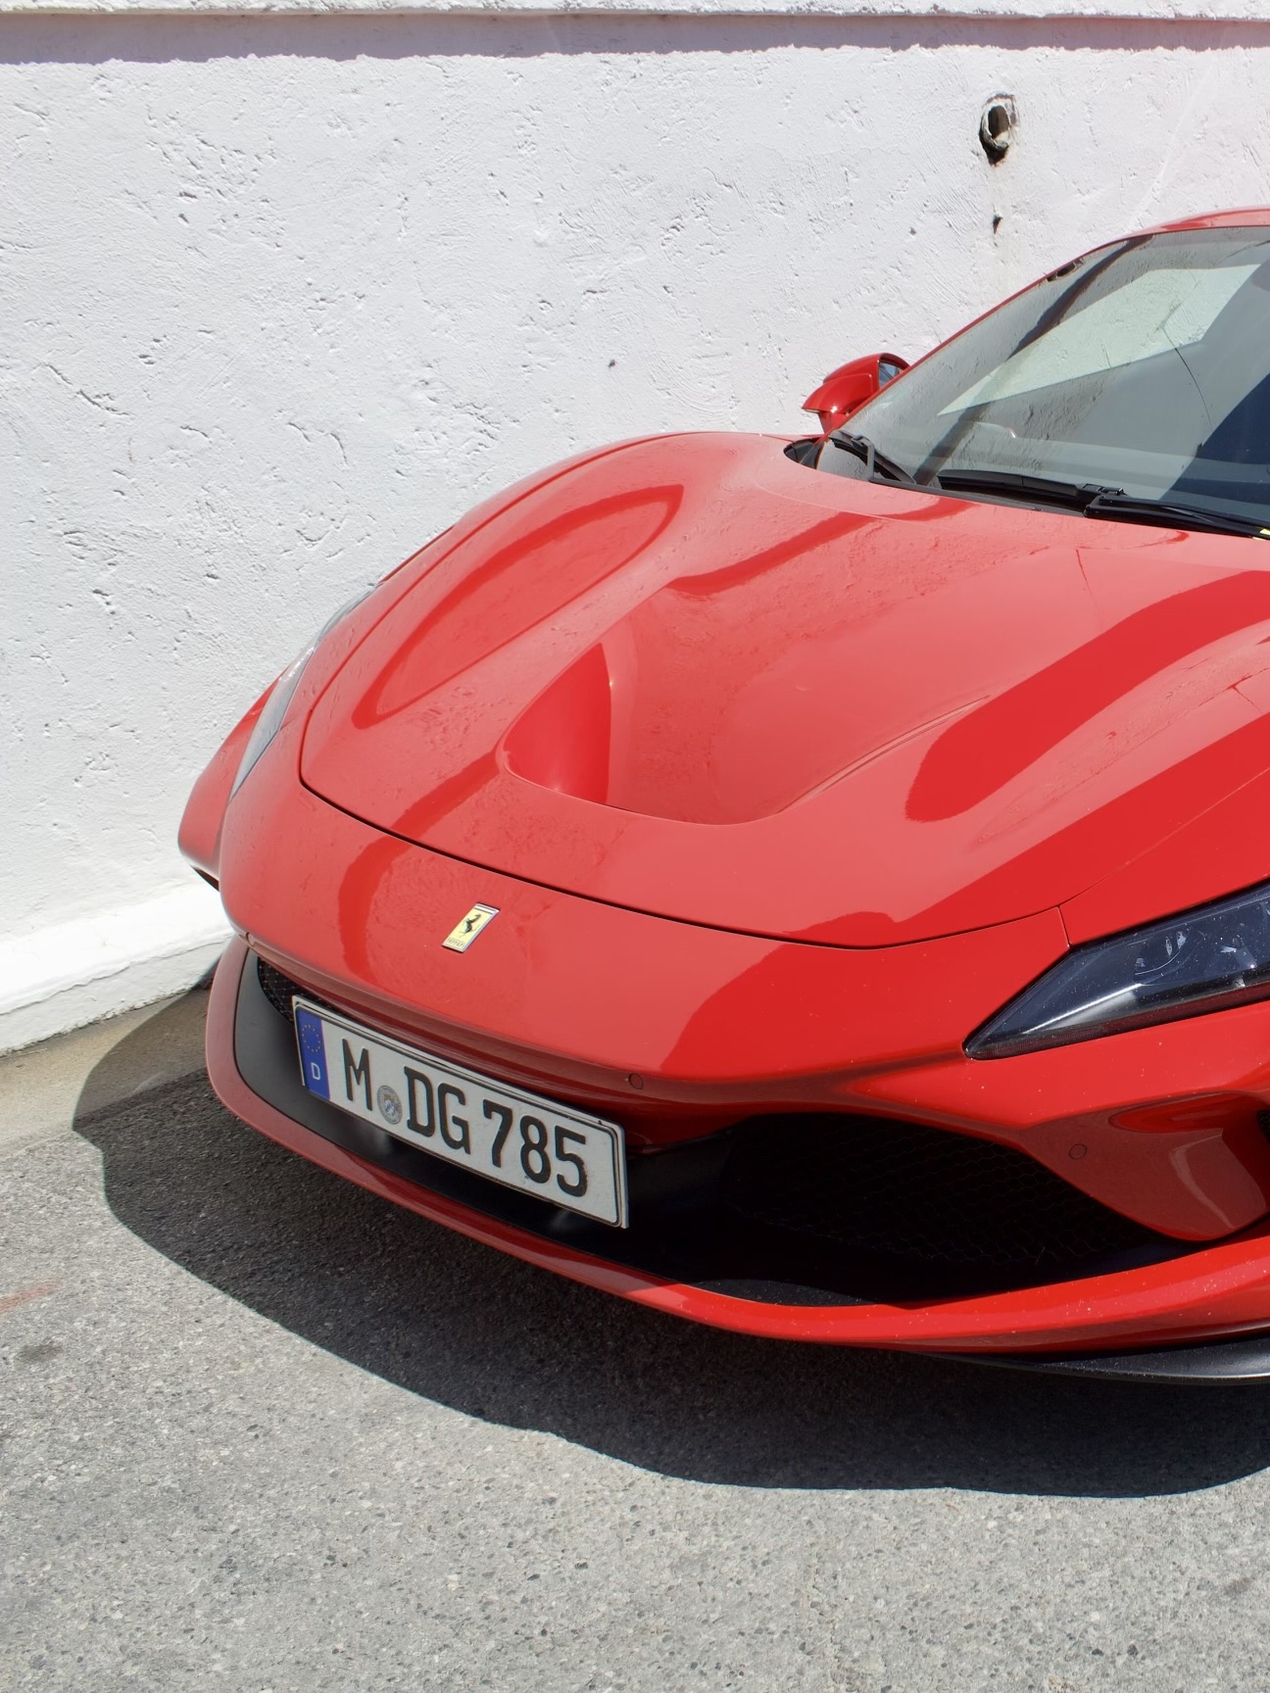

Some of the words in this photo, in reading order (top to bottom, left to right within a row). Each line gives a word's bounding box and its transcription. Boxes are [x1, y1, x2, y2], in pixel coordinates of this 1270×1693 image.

[311, 1062, 321, 1081] D
[342, 1038, 373, 1112] M
[404, 1066, 471, 1155] DG
[483, 1099, 588, 1198] 785
